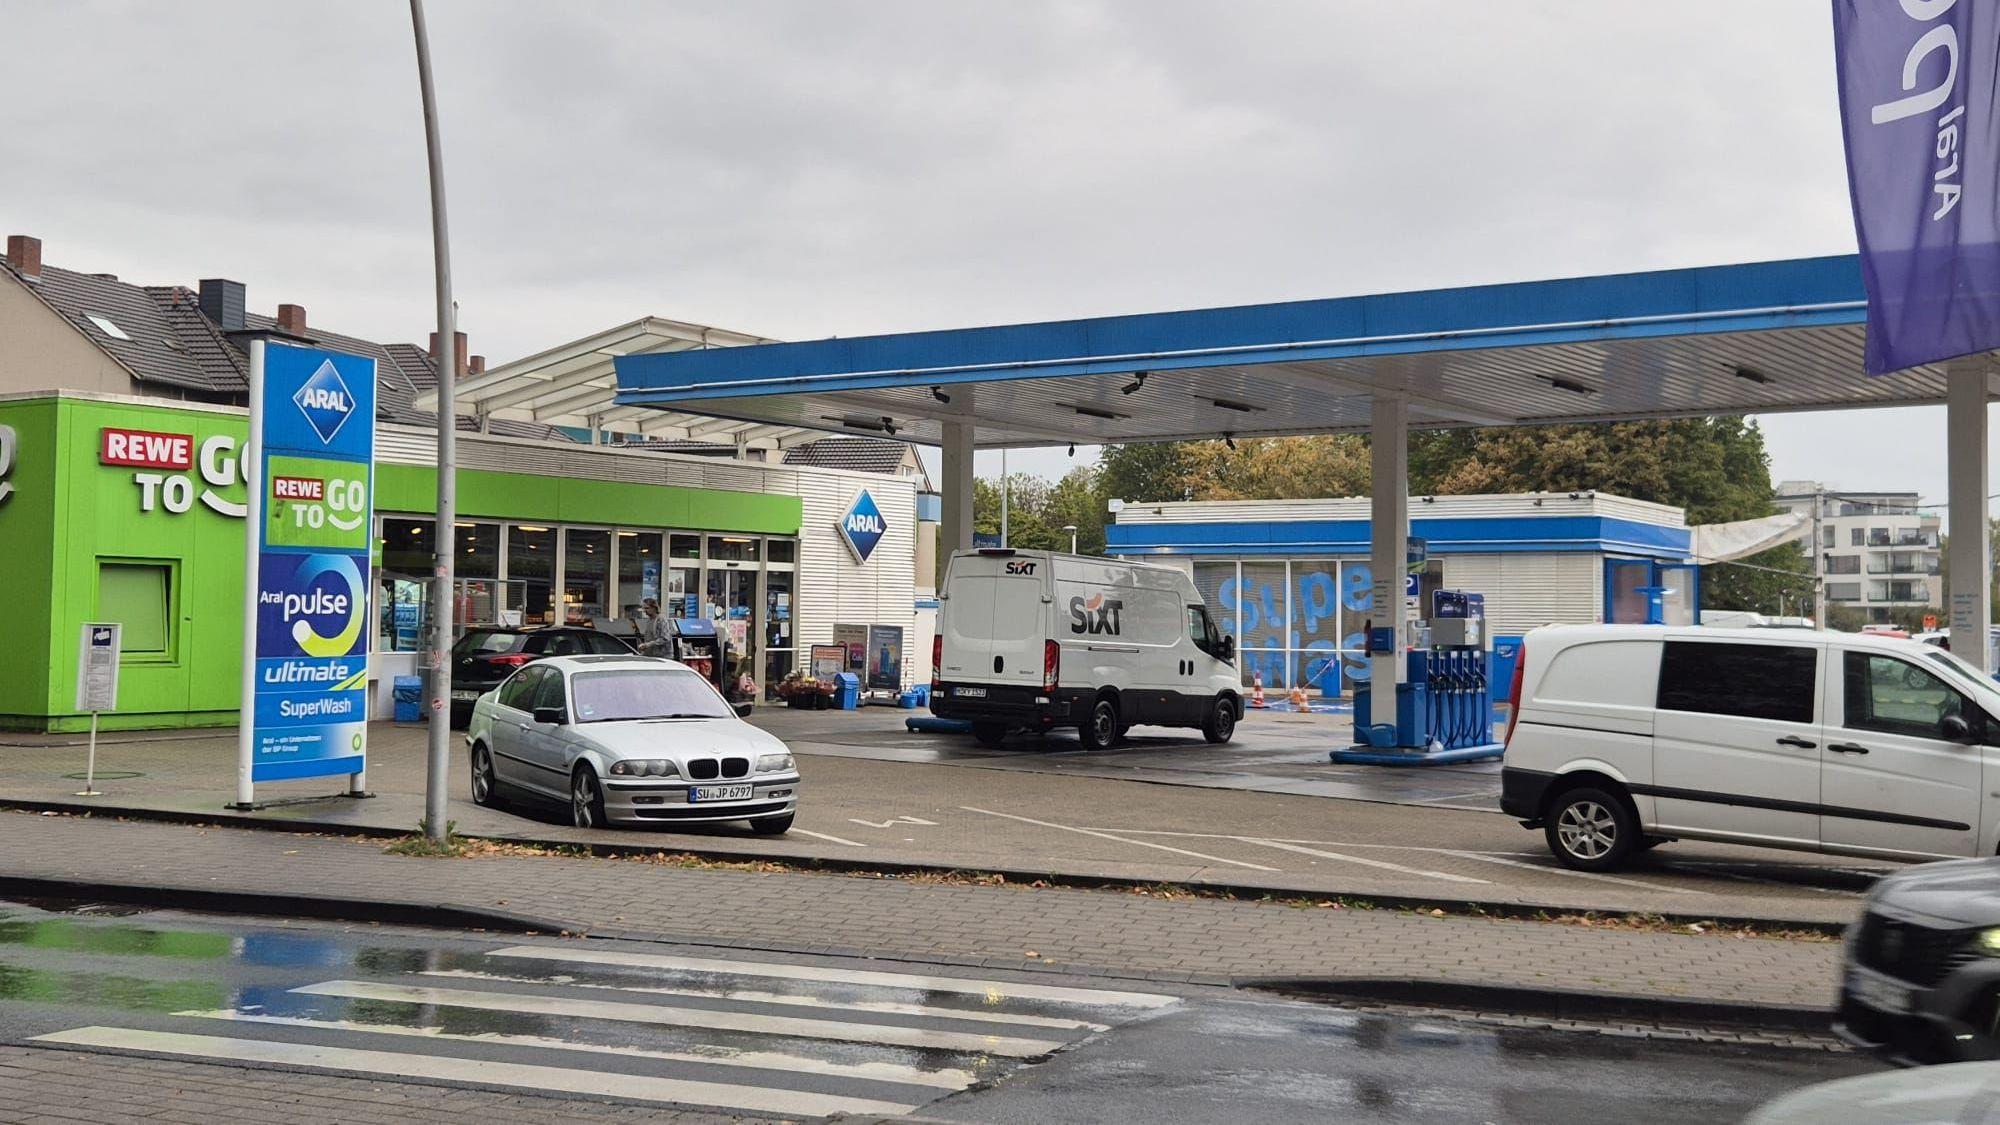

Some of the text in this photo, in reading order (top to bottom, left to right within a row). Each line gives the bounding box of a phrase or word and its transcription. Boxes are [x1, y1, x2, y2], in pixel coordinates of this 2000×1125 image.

[302, 388, 349, 413] ARAL
[107, 432, 189, 465] REWE
[134, 434, 249, 514] TO G
[275, 479, 323, 499] REWE
[292, 478, 365, 530] TO GO
[846, 513, 883, 534] ARAL
[260, 587, 348, 622] Aral pulse
[1218, 564, 1375, 634] Supe
[264, 660, 349, 683] ultimate
[1241, 629, 1374, 689] Was
[279, 698, 352, 719] SuperWash
[697, 786, 751, 800] SU JP 6797
